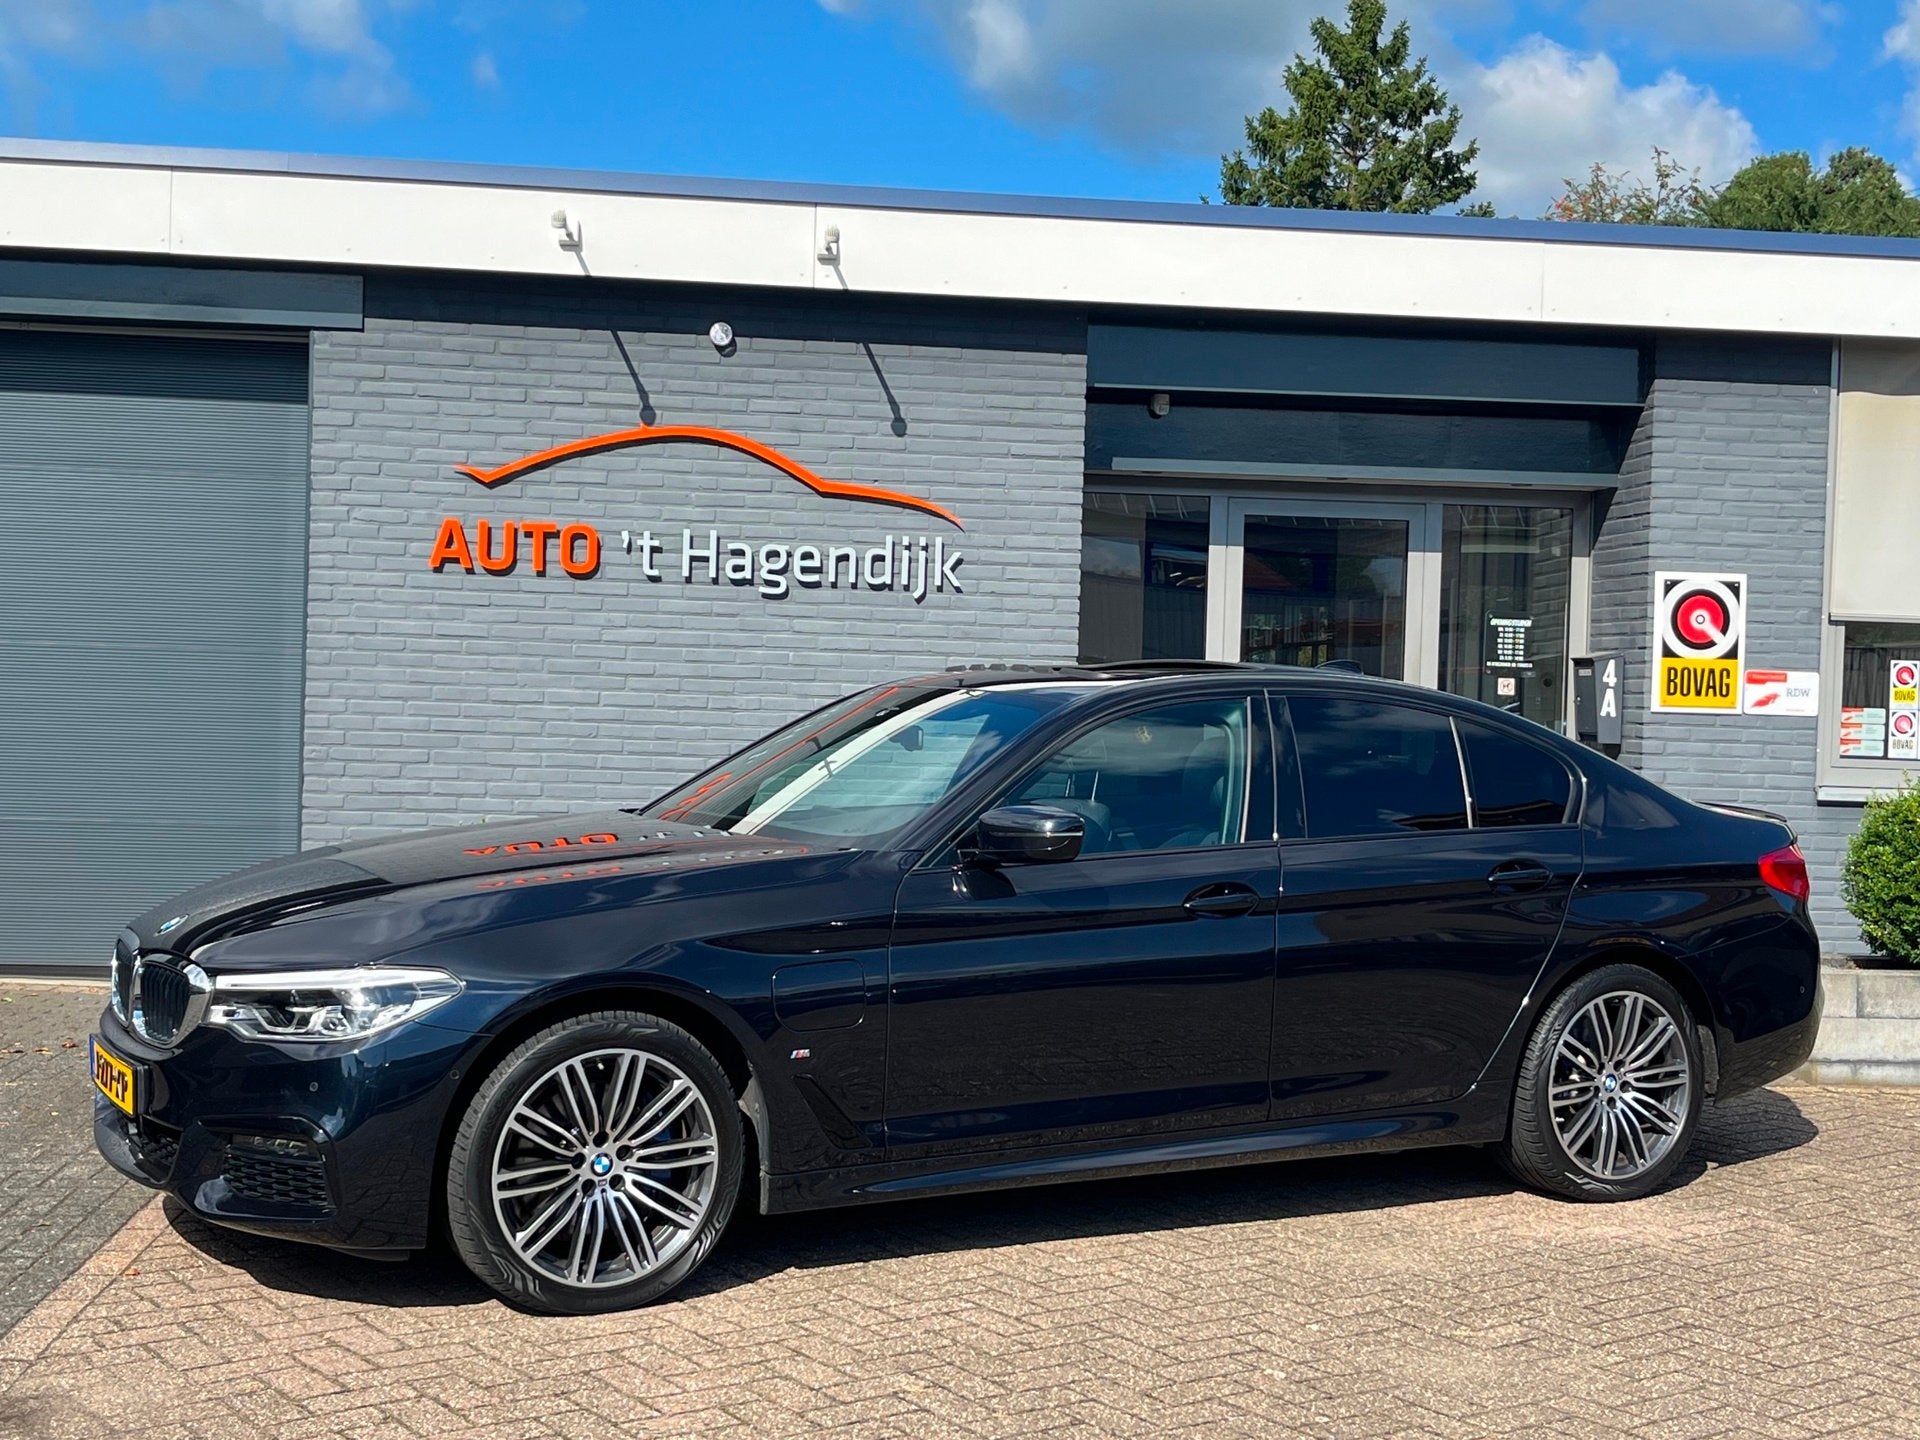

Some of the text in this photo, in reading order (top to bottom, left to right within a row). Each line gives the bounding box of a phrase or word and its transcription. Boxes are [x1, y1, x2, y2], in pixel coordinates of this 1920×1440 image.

[428, 517, 600, 574] AUTO
[681, 529, 962, 600] Hagendijk
[1602, 659, 1617, 687] 4
[1666, 666, 1731, 698] BOVAG
[1600, 688, 1616, 717] A
[1785, 688, 1811, 697] RDW
[1894, 690, 1916, 701] BOVAG
[1892, 740, 1914, 749] BOVAG
